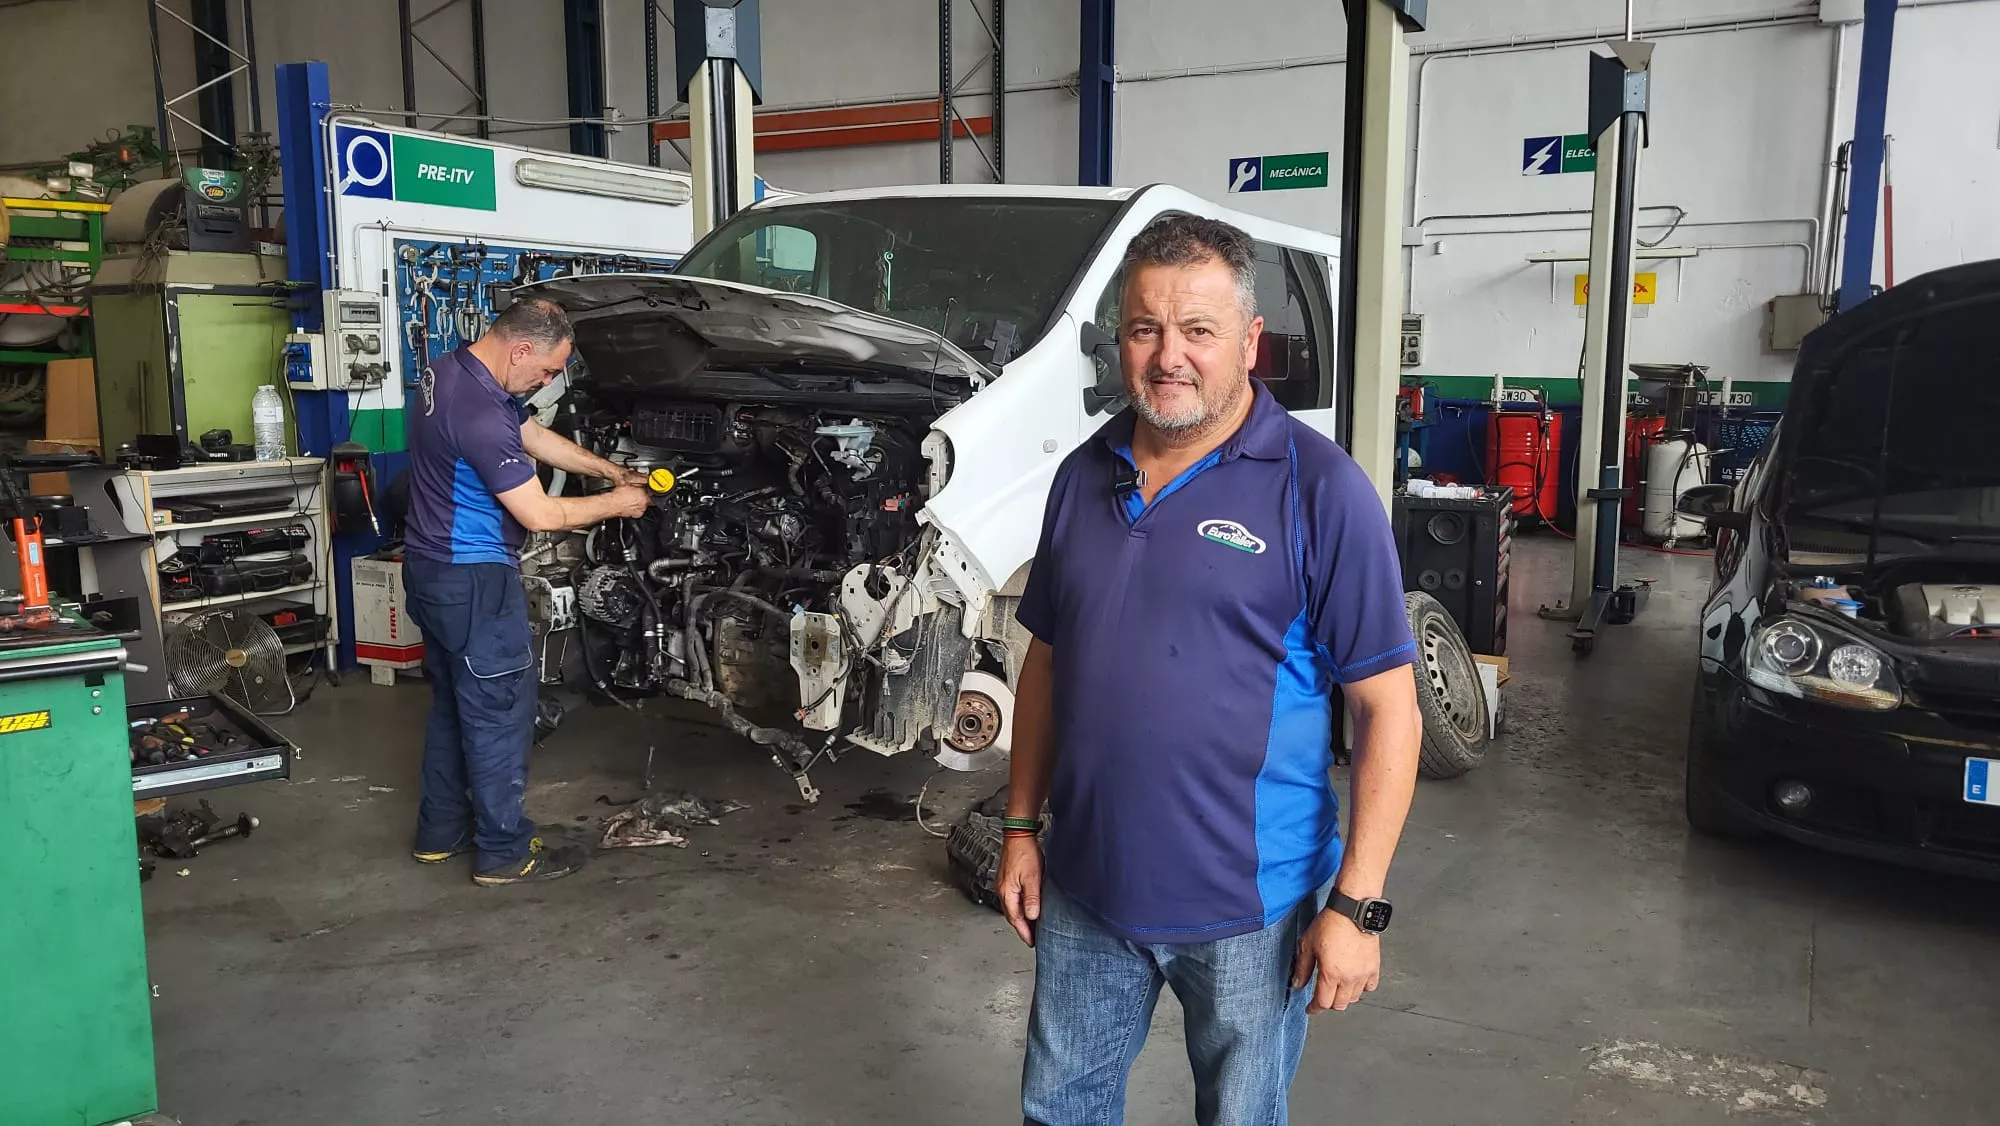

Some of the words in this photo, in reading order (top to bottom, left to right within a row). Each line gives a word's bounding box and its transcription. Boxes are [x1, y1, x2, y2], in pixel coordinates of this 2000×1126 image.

[417, 163, 475, 185] PRE-ITV
[1269, 166, 1322, 178] MECÁNICA
[1206, 526, 1256, 548] EuroTaller
[1972, 784, 1982, 794] E
